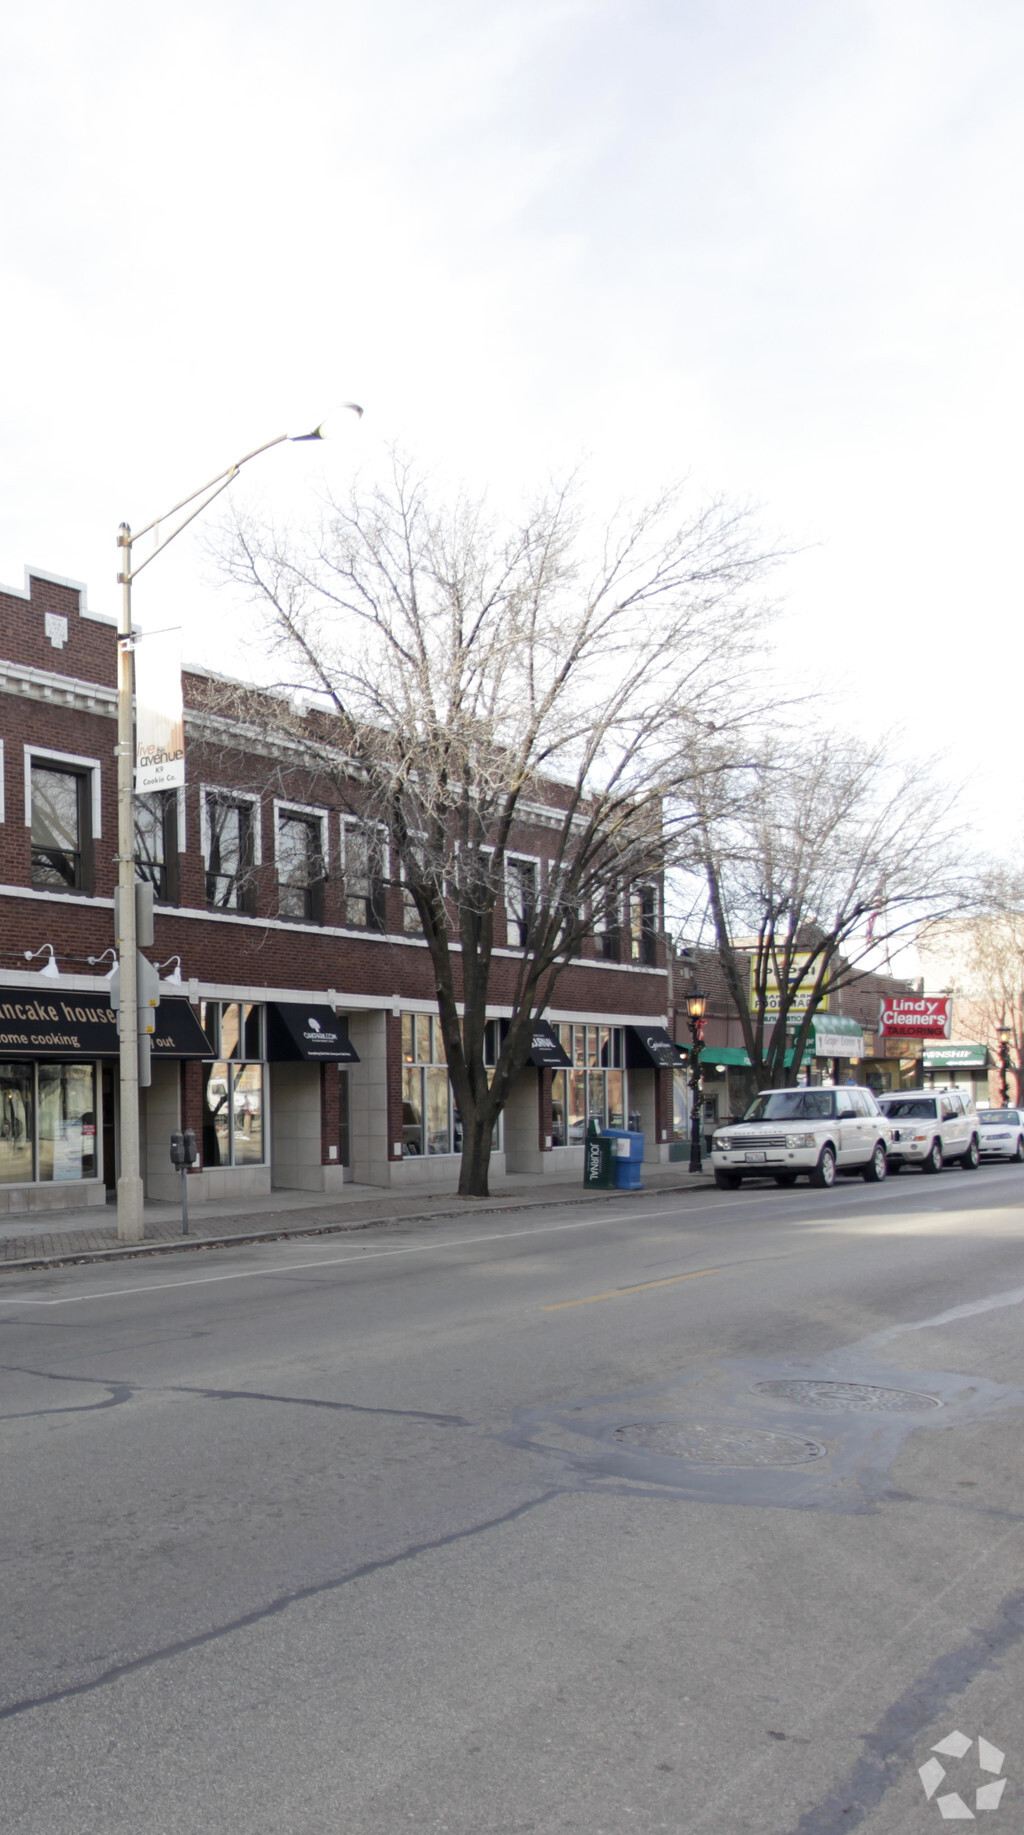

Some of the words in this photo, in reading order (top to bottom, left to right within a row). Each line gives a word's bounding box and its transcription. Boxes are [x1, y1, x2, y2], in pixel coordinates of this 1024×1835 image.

[137, 741, 155, 757] live
[140, 749, 184, 767] avenue
[155, 766, 164, 774] K9
[143, 776, 164, 786] Cookie
[166, 774, 176, 782] Co.
[61, 1003, 116, 1024] house
[893, 999, 939, 1014] Lindy
[883, 1011, 946, 1025] Cleaners
[888, 1027, 943, 1035] TAILORING
[31, 1033, 80, 1047] cooking
[157, 1037, 175, 1048] out
[589, 1142, 600, 1181] JOURNAL
